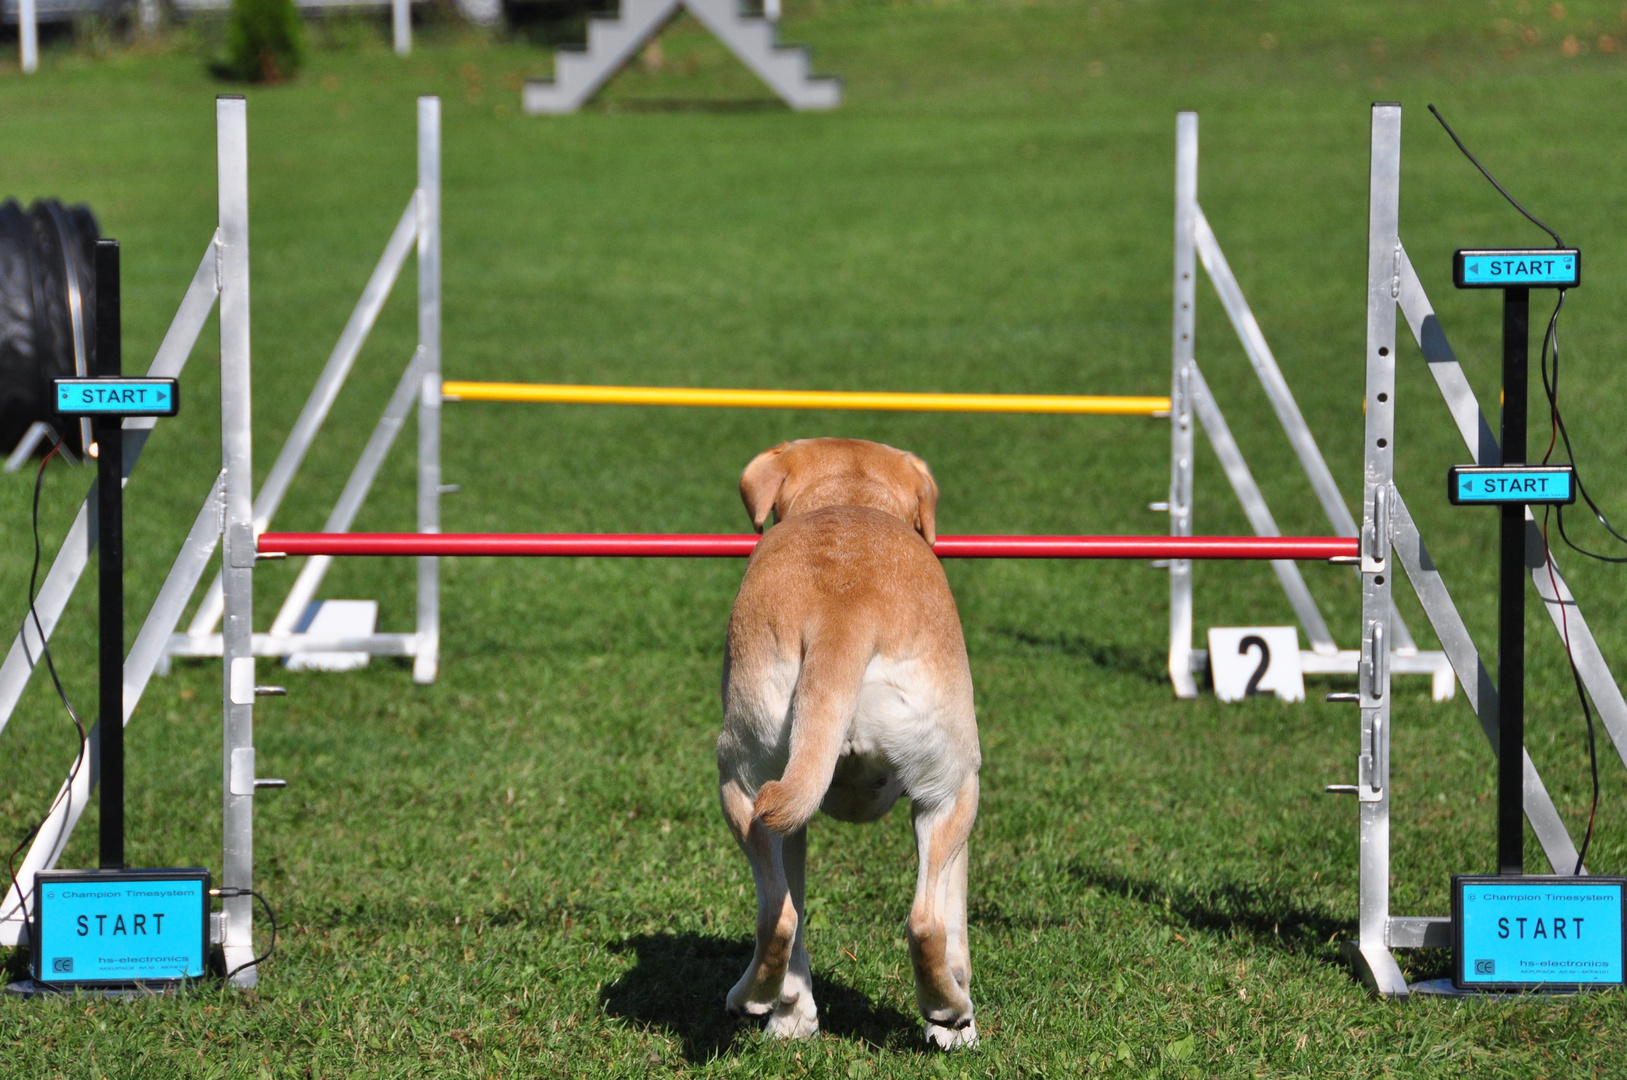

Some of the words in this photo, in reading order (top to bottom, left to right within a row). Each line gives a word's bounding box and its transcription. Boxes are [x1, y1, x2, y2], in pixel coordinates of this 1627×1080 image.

[1490, 261, 1555, 275] START
[82, 389, 147, 403] START
[1484, 478, 1549, 492] START
[1239, 635, 1275, 697] 2
[62, 891, 121, 899] Champion
[125, 890, 194, 898] Timesystem
[1483, 893, 1541, 901] Champion
[1545, 893, 1614, 901] Timesystem
[76, 914, 164, 936] START
[1498, 917, 1584, 939] START
[54, 959, 70, 972] CE
[98, 955, 189, 964] hs-electronics
[1476, 961, 1492, 973] CE
